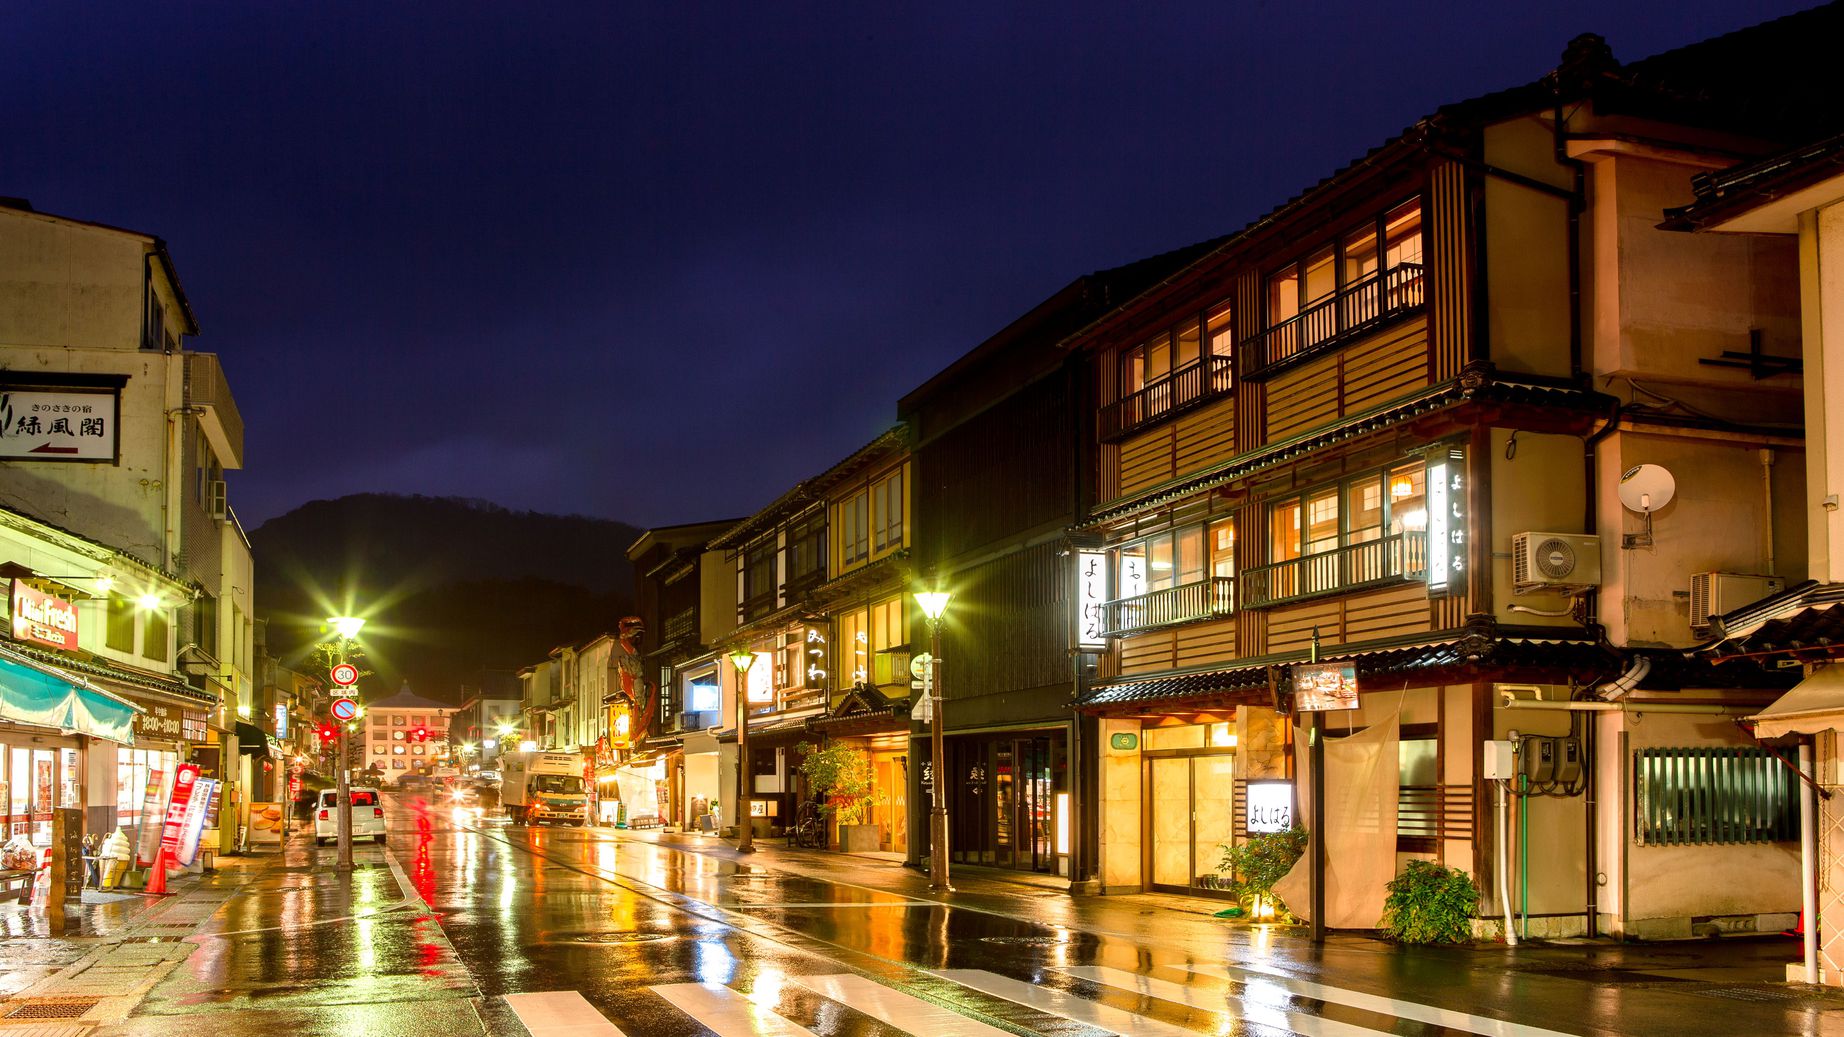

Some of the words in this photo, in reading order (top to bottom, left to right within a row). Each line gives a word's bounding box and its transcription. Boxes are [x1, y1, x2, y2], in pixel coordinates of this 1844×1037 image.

[31, 404, 92, 413] きのさきの宿
[15, 415, 105, 438] 緑風閣
[1450, 474, 1464, 572] よしはる
[1084, 559, 1101, 639] よしはる
[807, 630, 826, 680] みつわ
[337, 670, 352, 680] 30
[1250, 804, 1290, 828] よしはる
